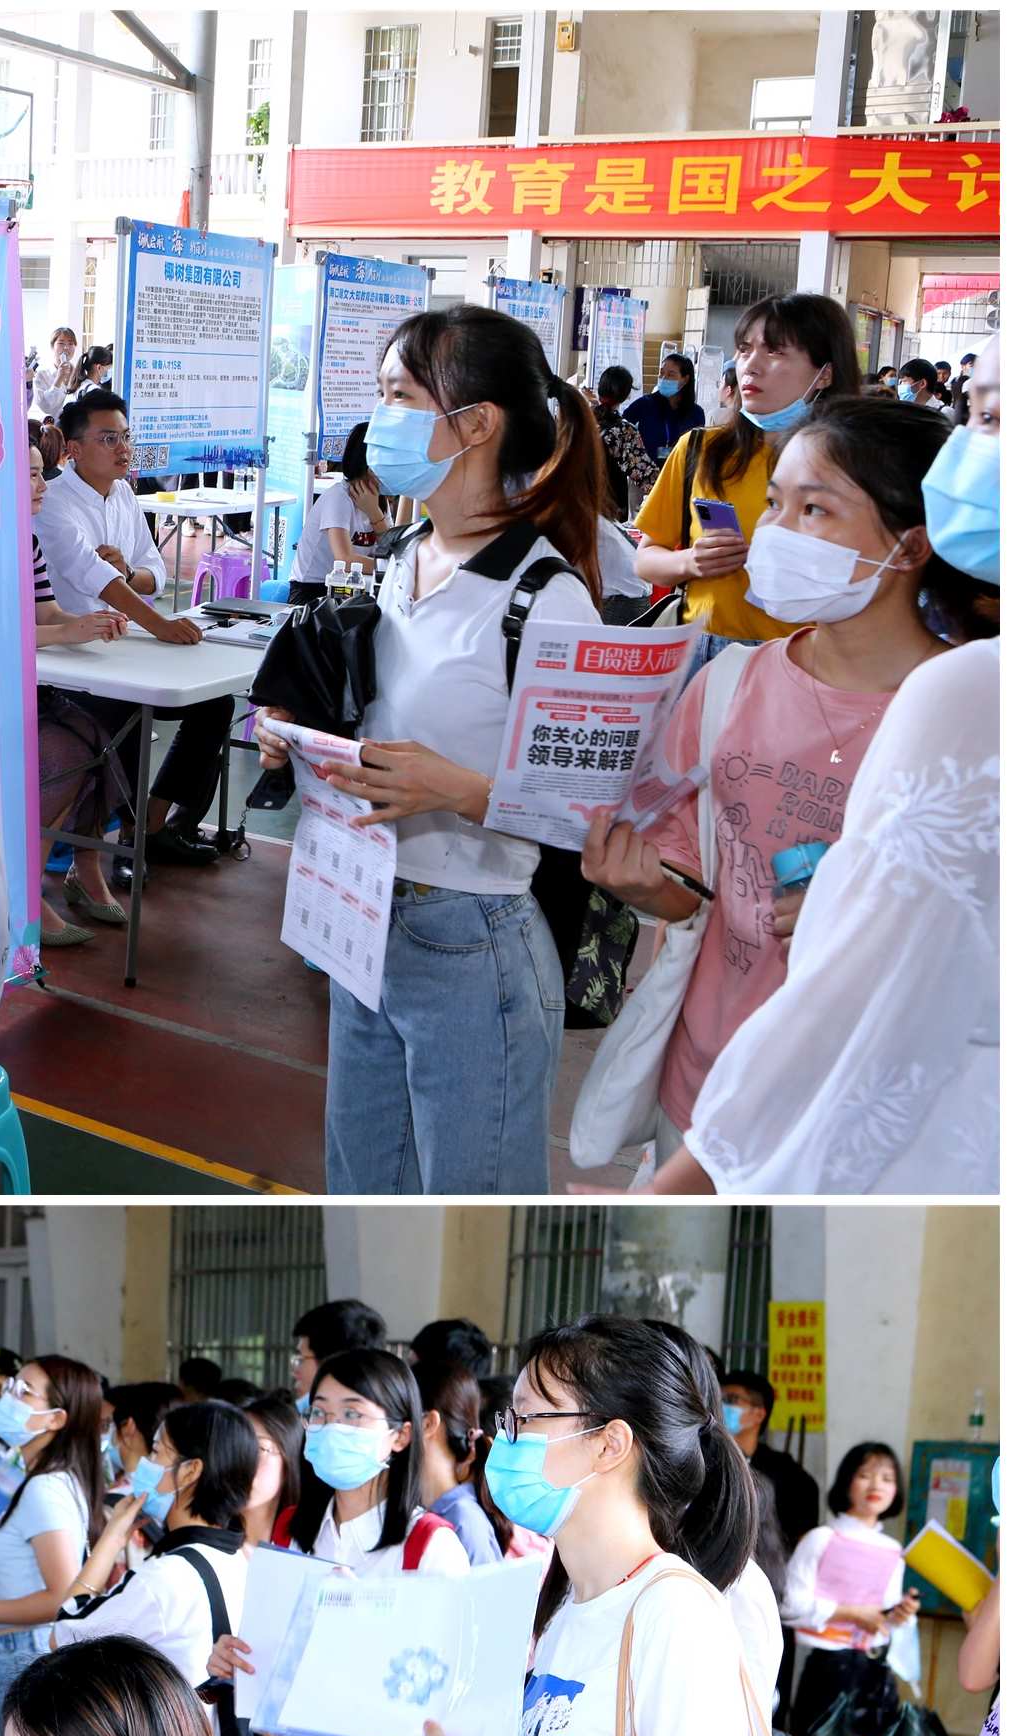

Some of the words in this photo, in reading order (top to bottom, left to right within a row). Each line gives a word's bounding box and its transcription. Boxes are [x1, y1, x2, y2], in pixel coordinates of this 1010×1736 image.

[429, 152, 1000, 216] 教育是国之大计
[164, 261, 242, 289] 椰树集团有限公司
[532, 724, 641, 748] 你关心的问题
[527, 743, 637, 772] 领导来解答
[776, 761, 853, 808] DAR
